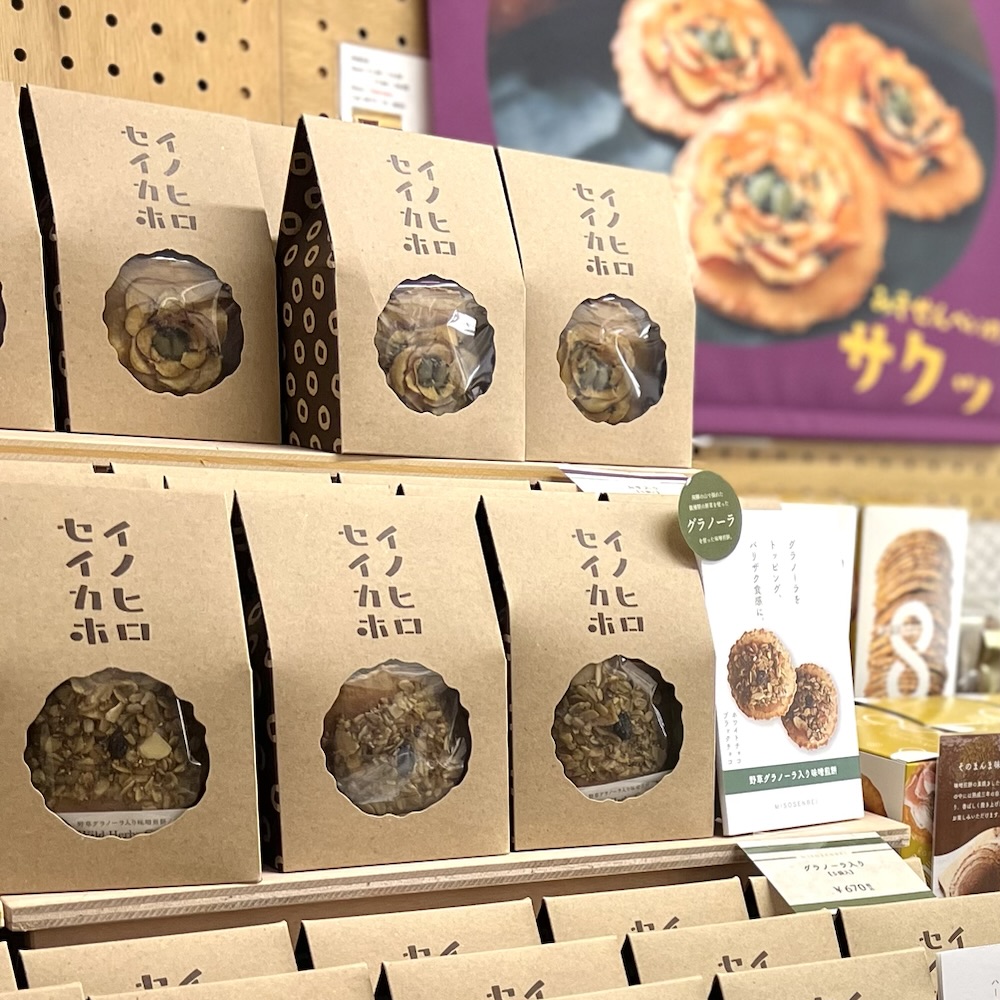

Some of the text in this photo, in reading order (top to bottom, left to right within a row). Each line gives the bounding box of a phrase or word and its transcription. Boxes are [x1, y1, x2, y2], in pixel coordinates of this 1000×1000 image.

[838, 319, 994, 416] サクッ
[687, 513, 735, 534] グラノーラ
[57, 519, 108, 644] セイカホ
[104, 520, 150, 641] イノヒロ
[338, 525, 388, 639] セイカホ
[376, 525, 422, 635] イノヒロ
[572, 528, 615, 636] セイカホ
[603, 530, 644, 632] イノヒロ
[749, 765, 838, 785] 野草グラノーラ入り味噌煎餅
